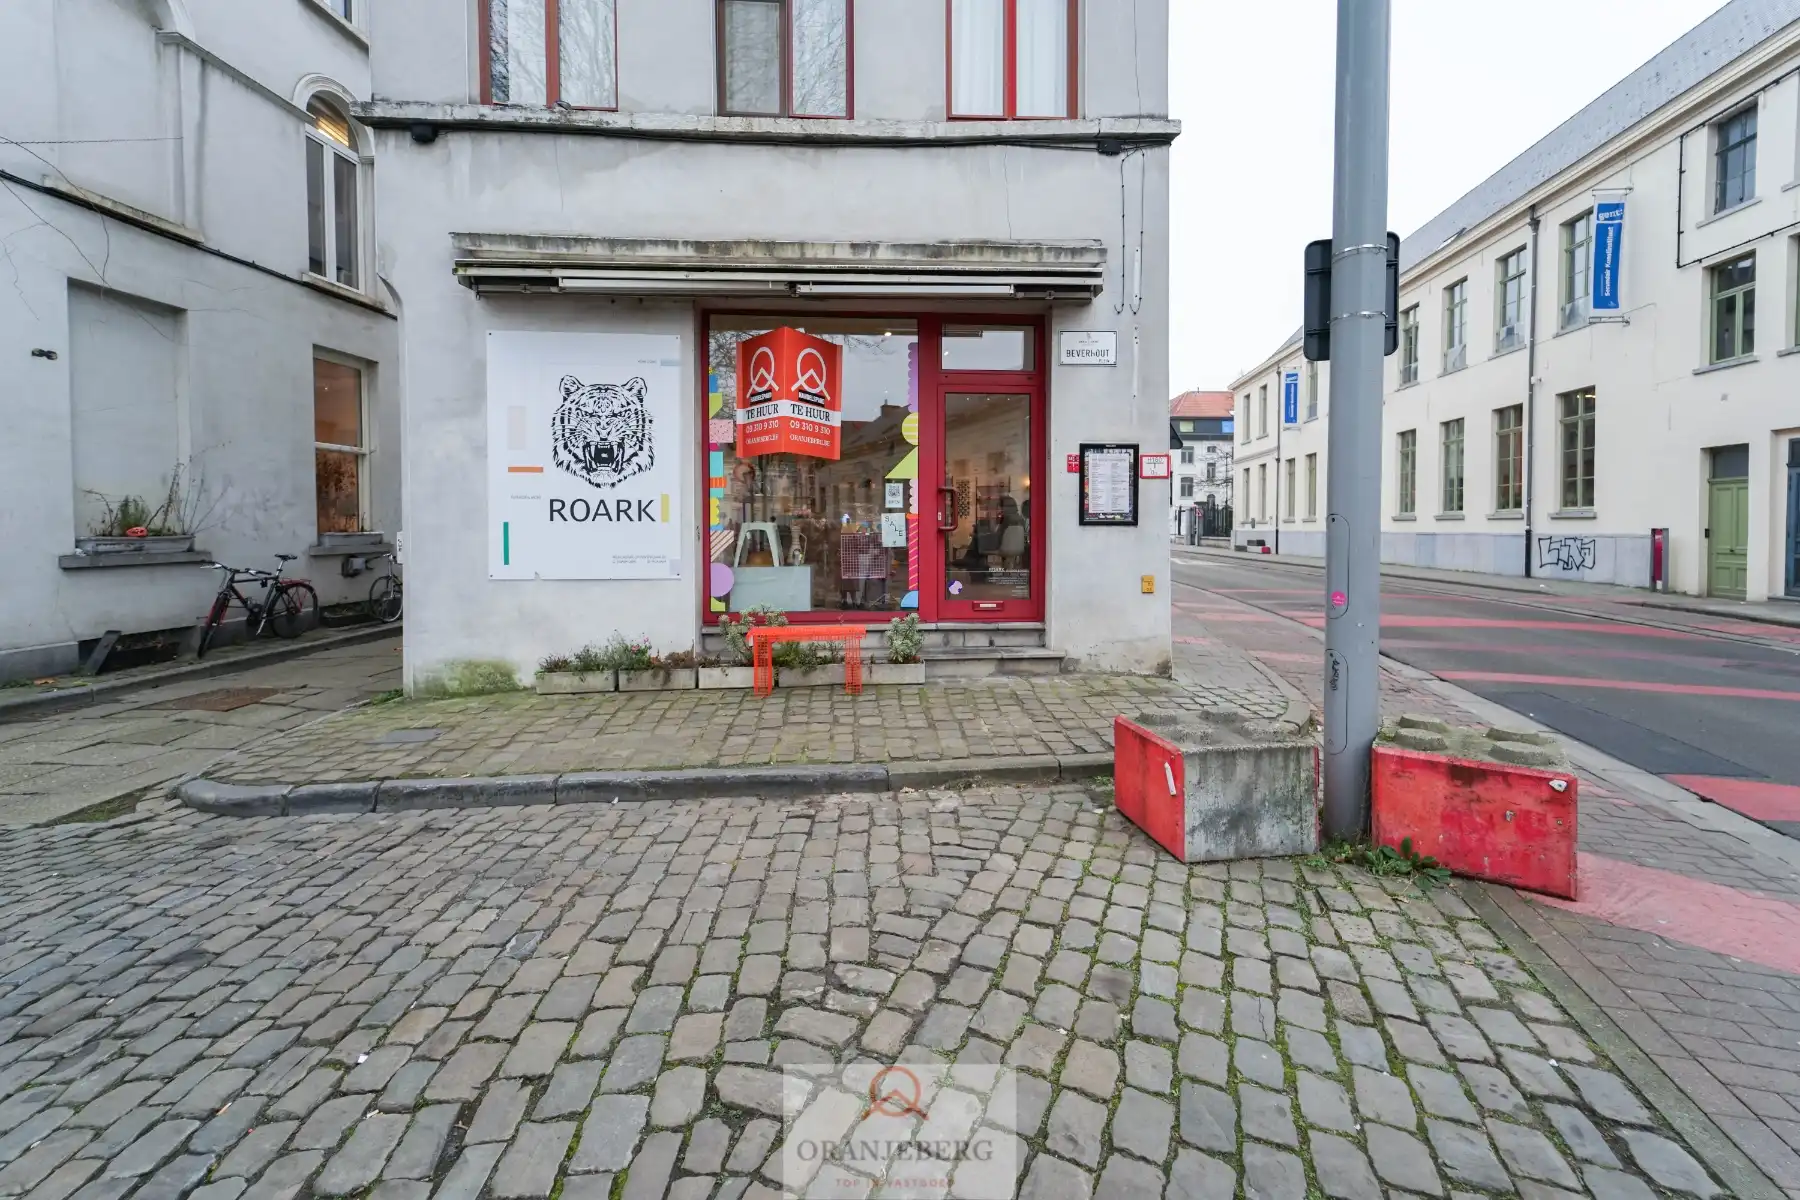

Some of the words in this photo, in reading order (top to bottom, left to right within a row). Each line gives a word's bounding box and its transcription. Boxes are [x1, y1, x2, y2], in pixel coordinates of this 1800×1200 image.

[746, 408, 756, 420] TE
[757, 403, 779, 418] HUUR
[790, 403, 803, 416] TE
[805, 406, 831, 422] HUUR
[745, 424, 753, 433] 09
[763, 421, 768, 430] 9
[789, 419, 801, 429] 09
[801, 421, 813, 432] 310
[814, 424, 819, 433] 9
[549, 498, 656, 522] ROARK
[884, 516, 903, 537] SALE
